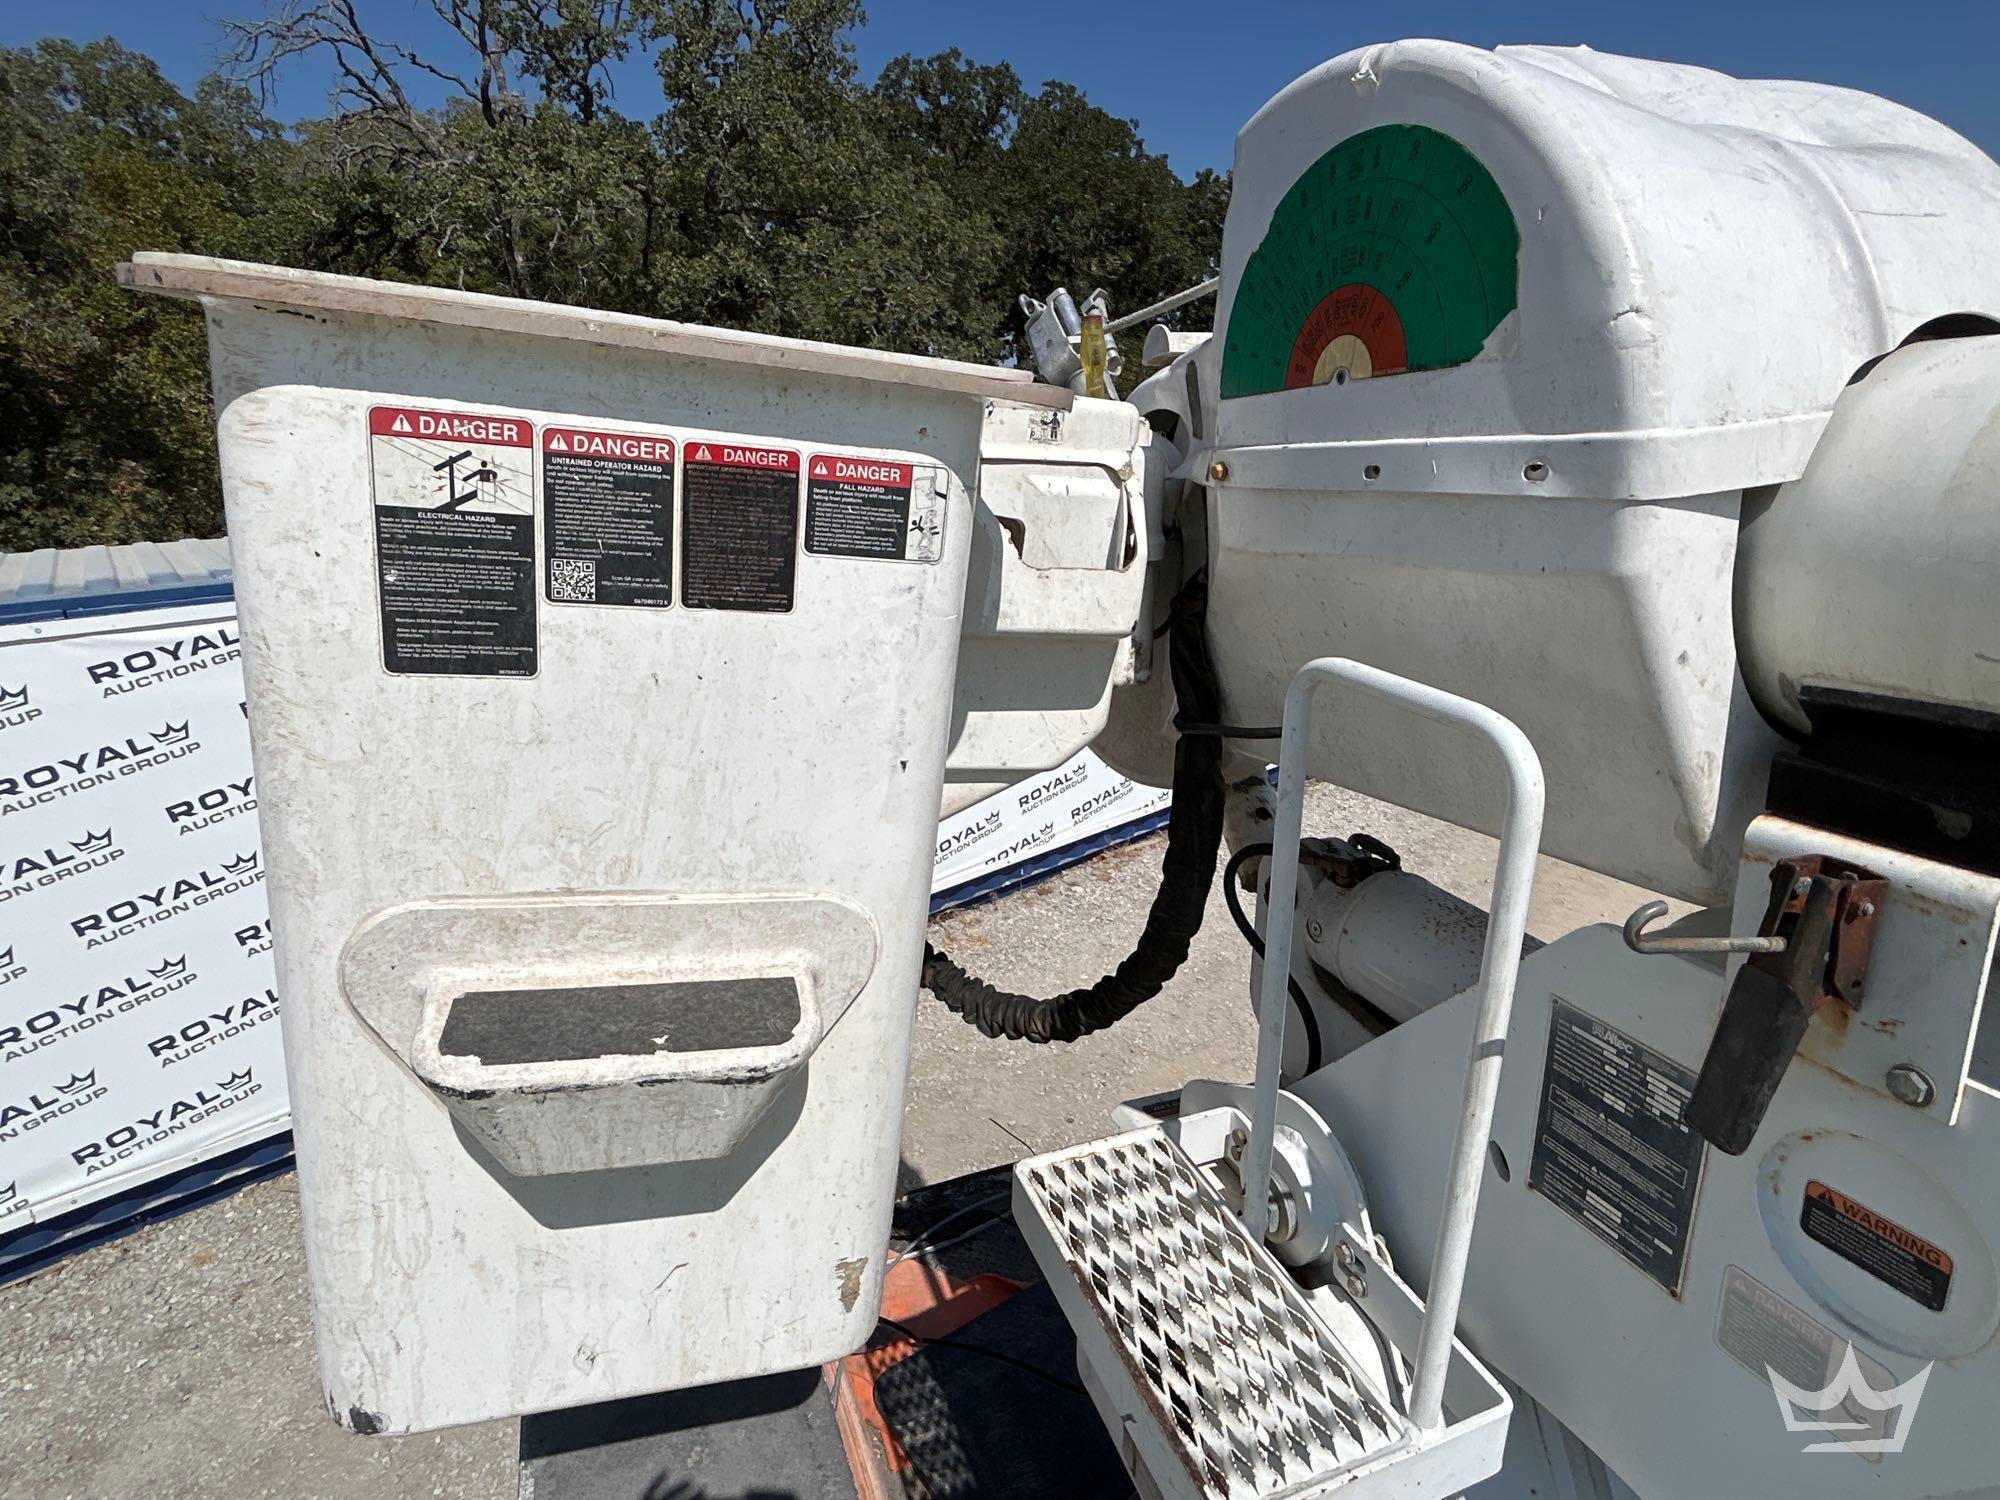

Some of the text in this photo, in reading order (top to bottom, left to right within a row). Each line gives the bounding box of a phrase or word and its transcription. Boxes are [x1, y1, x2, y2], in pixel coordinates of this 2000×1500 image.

[419, 415, 518, 442] DANGER
[573, 434, 670, 460] DANGER
[551, 457, 662, 473] UNTRAINED OPERATOR HAZARD
[723, 448, 789, 467] DANGER
[835, 463, 901, 483] DANGER
[858, 485, 885, 493] HAZARD
[418, 511, 496, 523] ELECTRICAL HAZARD
[86, 629, 240, 684] ROYAL
[102, 658, 208, 699] AUCTION
[0, 738, 155, 798] ROYAL
[1, 741, 201, 816] AUCTION GROUP
[165, 776, 254, 824] ROY
[1019, 773, 1074, 808] ROYAL
[1021, 774, 1089, 815] AUCTION GROUP
[1071, 786, 1120, 819] ROYAL
[1073, 805, 1107, 827] AUCTION
[1108, 786, 1135, 808] GROUP
[179, 800, 258, 836] AUCTIO
[971, 822, 1003, 844] GROUP
[38, 849, 126, 887] GROUP
[70, 870, 225, 937] ROYAL
[86, 900, 190, 950] AUCTION
[0, 977, 152, 1049] ROYAL
[5, 972, 198, 1063] AUCTION GROUP
[161, 1018, 256, 1068] AUCTION
[22, 1086, 109, 1131] GROUP
[71, 1089, 221, 1166] ROYAL
[86, 1083, 263, 1177] AUCTION GROUP
[1842, 1199, 1942, 1265] WARNING
[1753, 1289, 1826, 1346] DANGER
